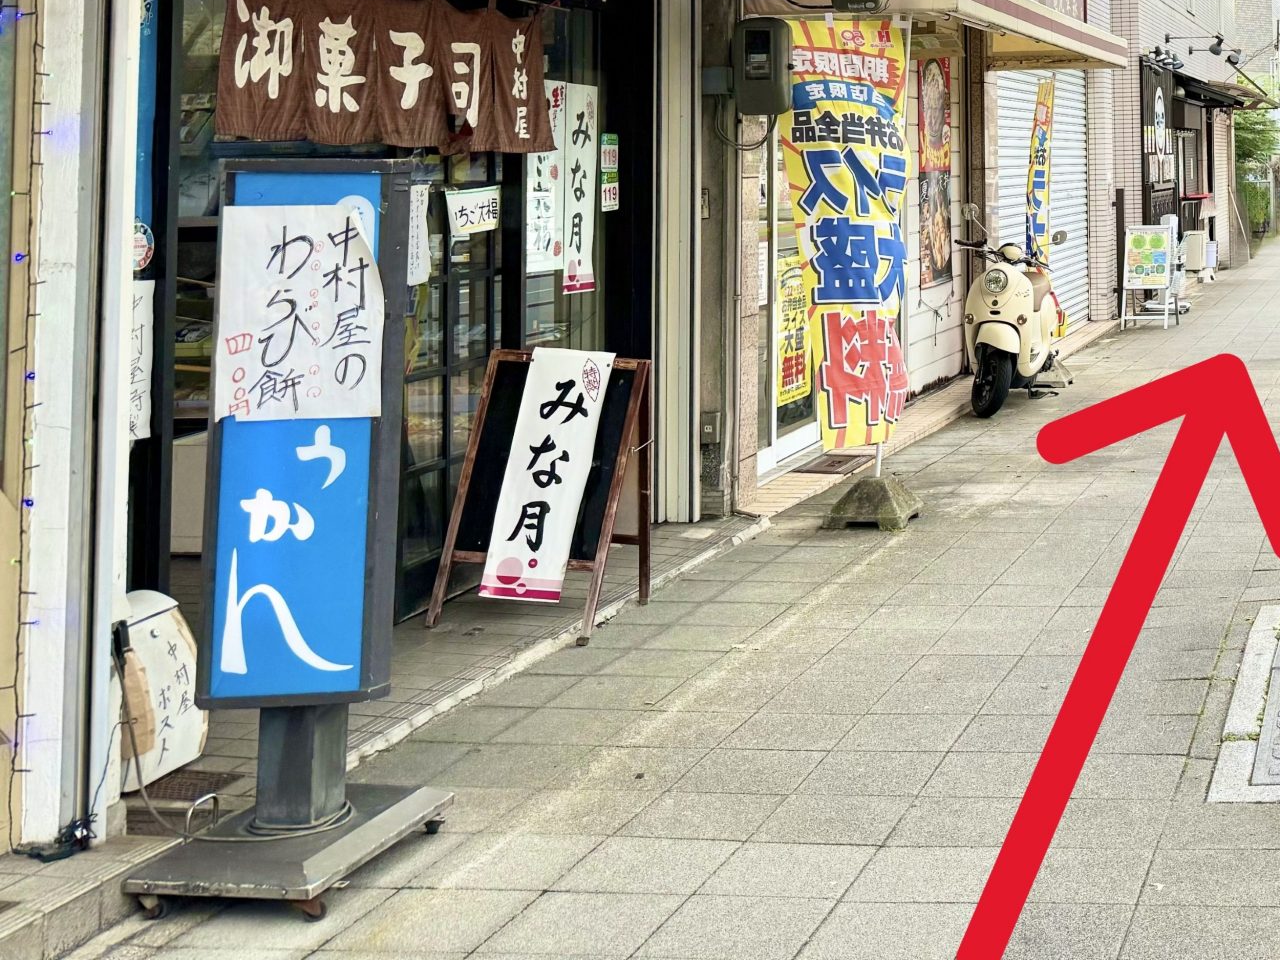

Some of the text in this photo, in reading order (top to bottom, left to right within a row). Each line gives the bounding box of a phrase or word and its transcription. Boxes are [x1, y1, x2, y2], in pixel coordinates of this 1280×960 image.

[511, 28, 531, 139] 中村屋
[569, 110, 592, 255] みな月
[603, 148, 617, 166] 119
[603, 185, 617, 203] 119
[248, 225, 320, 413] わらび餅
[321, 216, 371, 390] 中村屋の
[782, 310, 806, 330] ライス
[781, 350, 806, 389] 無料
[506, 379, 589, 553] みな月
[167, 640, 192, 717] 中村屋
[158, 685, 174, 767] ポスト
